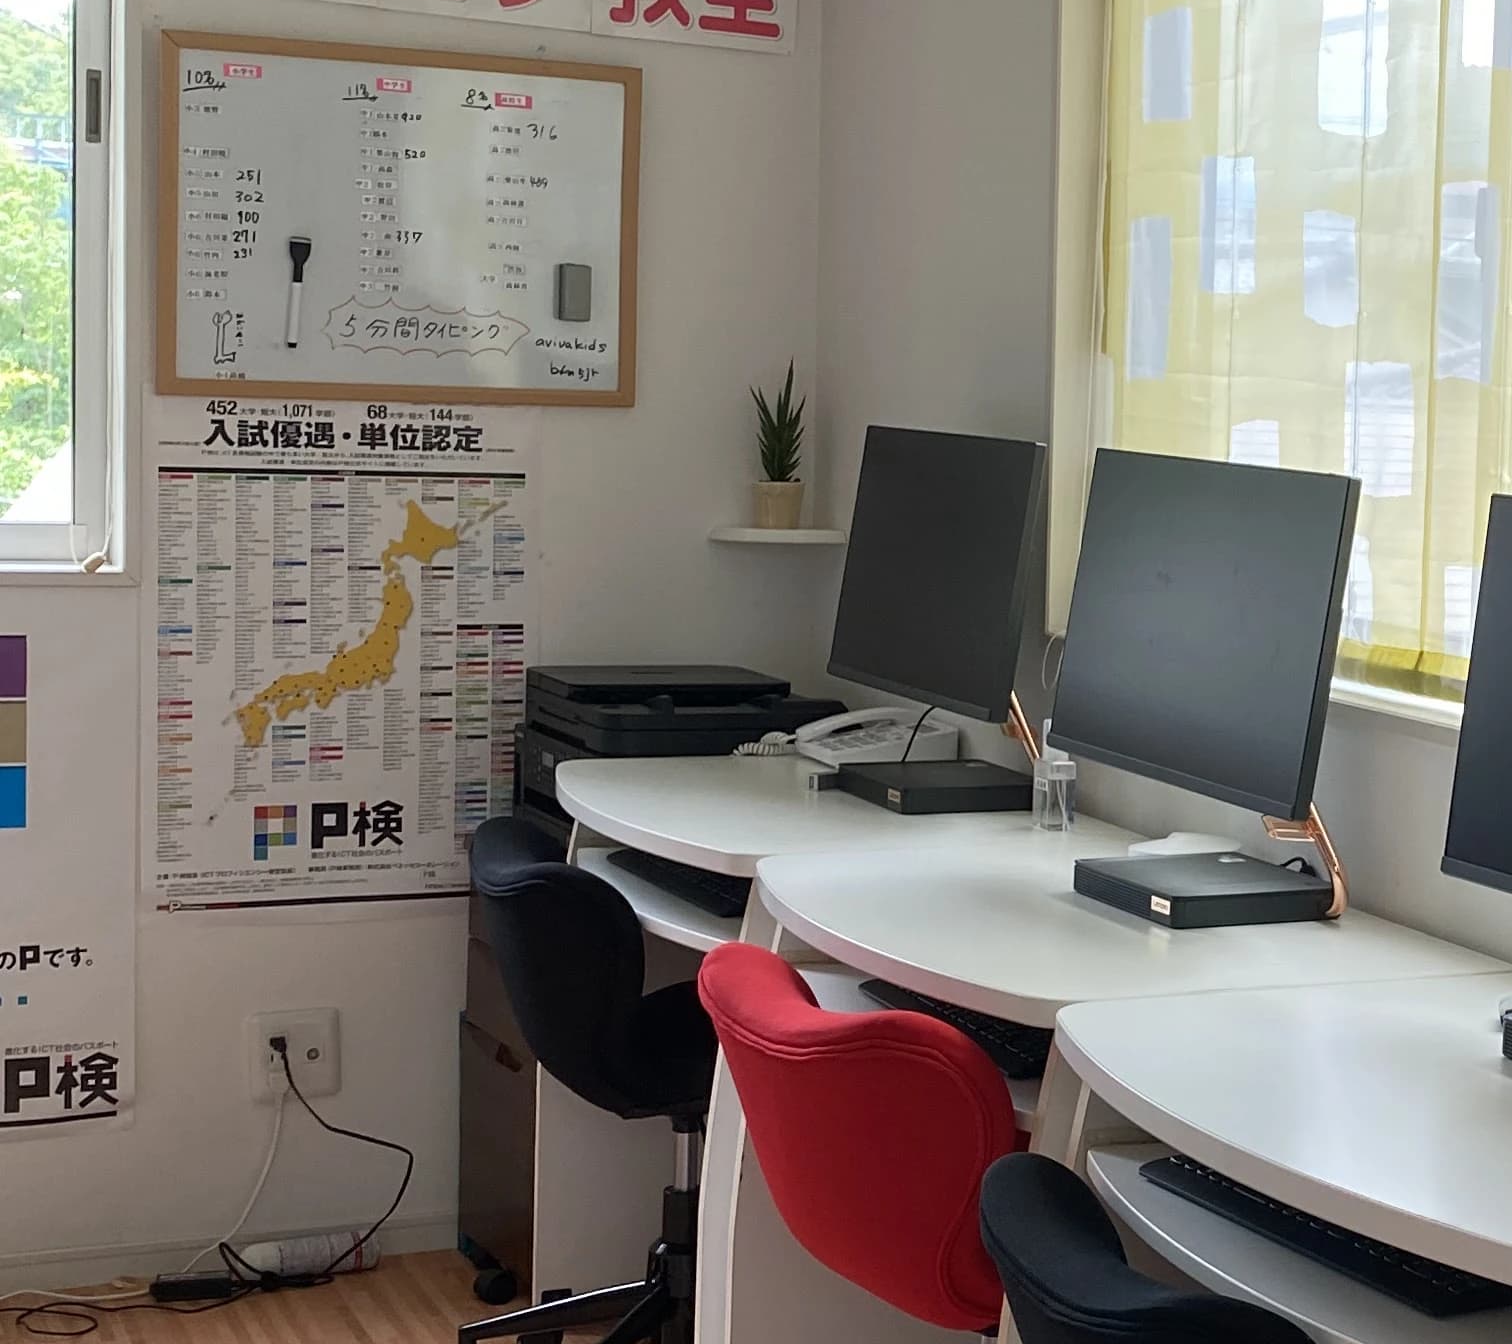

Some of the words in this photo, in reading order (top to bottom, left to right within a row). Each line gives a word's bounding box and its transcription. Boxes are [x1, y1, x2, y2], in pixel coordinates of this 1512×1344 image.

[236, 169, 262, 184] 251
[235, 191, 264, 204] 302
[204, 419, 483, 452] 入試優遇・単位認定
[311, 800, 404, 849] P検
[5, 1052, 119, 1113] P検
